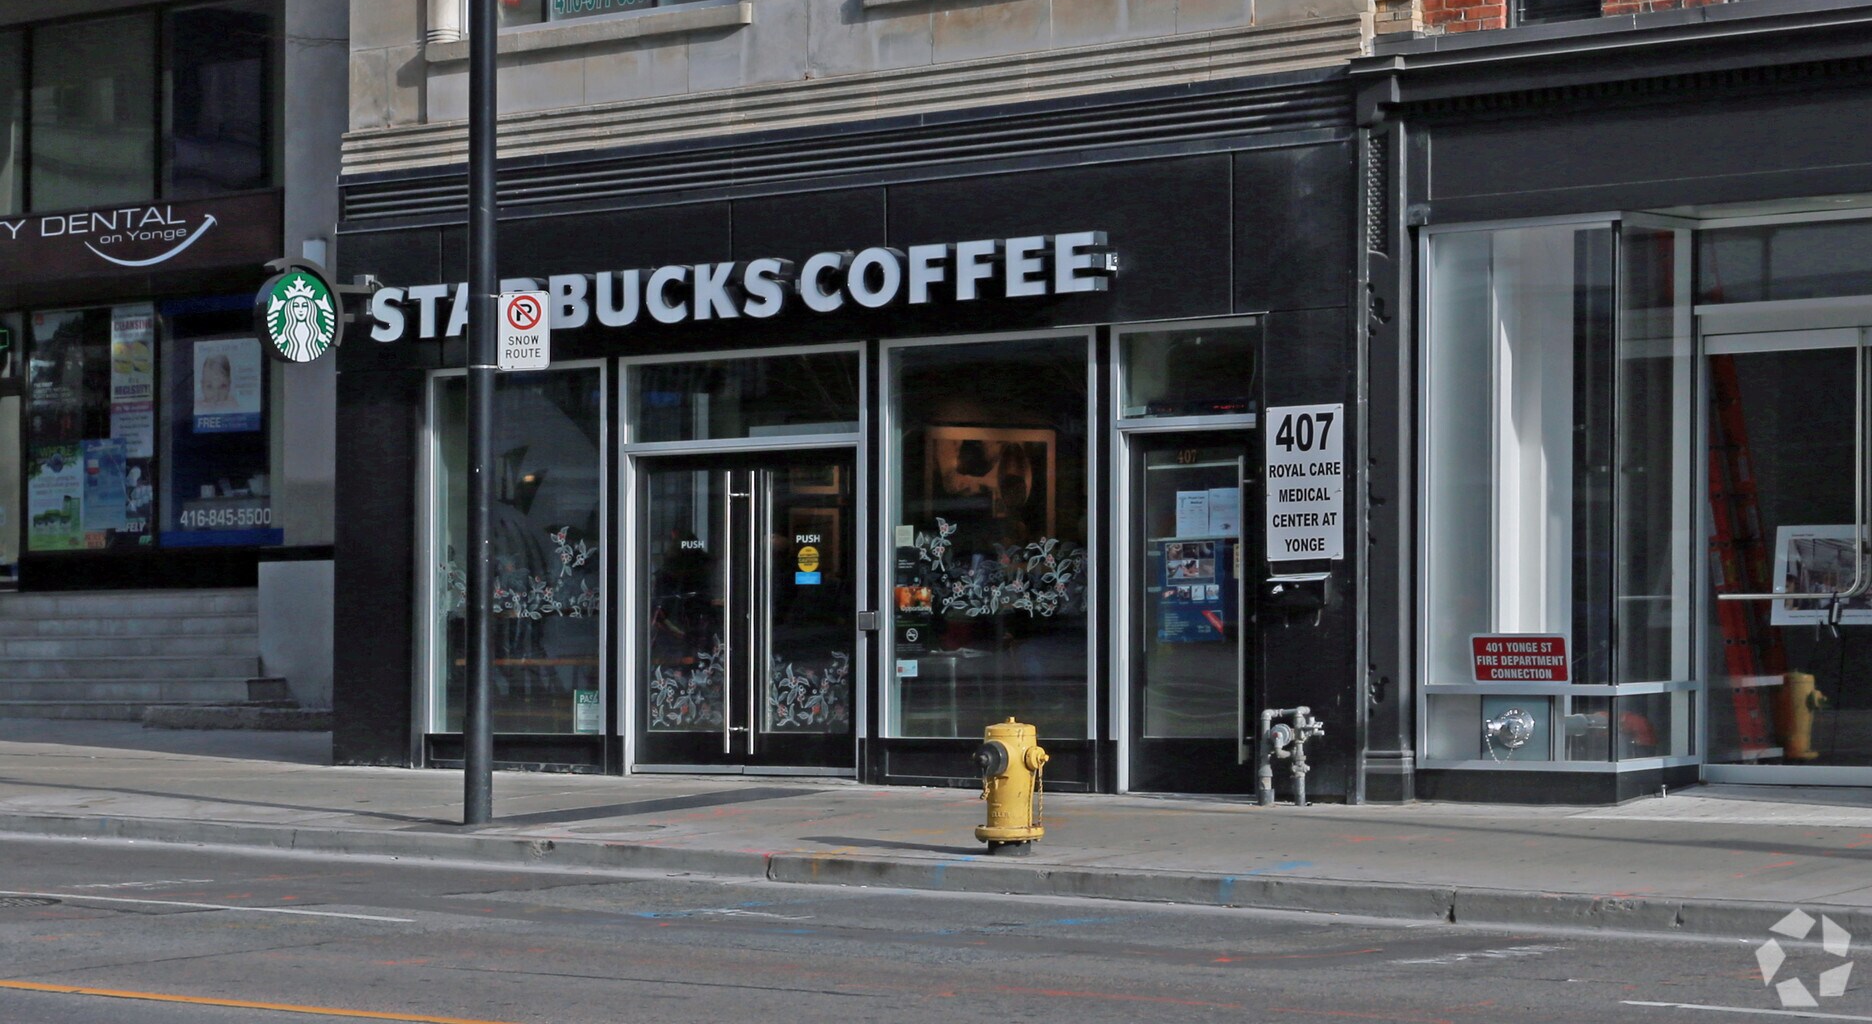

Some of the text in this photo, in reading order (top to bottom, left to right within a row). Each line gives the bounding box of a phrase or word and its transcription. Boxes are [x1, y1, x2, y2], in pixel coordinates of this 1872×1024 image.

[0, 205, 186, 240] Y DENTAL
[100, 228, 187, 244] on Yonge
[370, 230, 1108, 342] STABUCKS COFFEE
[508, 335, 539, 346] SNOW
[505, 348, 541, 359] ROUTE
[197, 416, 222, 428] FREE
[1275, 412, 1334, 452] 407
[1177, 448, 1198, 464] 407
[1269, 461, 1341, 478] ROYAL CARE
[1279, 487, 1331, 503] MEDICAL
[180, 508, 272, 527] 416-845-5500
[1272, 512, 1337, 528] CENTER AT
[681, 540, 705, 549] PUSH
[796, 534, 821, 544] PUSH
[1285, 537, 1325, 552] YONGE
[1486, 642, 1552, 653] 401 YONGE ST
[1477, 655, 1564, 666] FIRE DEPARTMENT
[1491, 668, 1553, 679] CONNECTION
